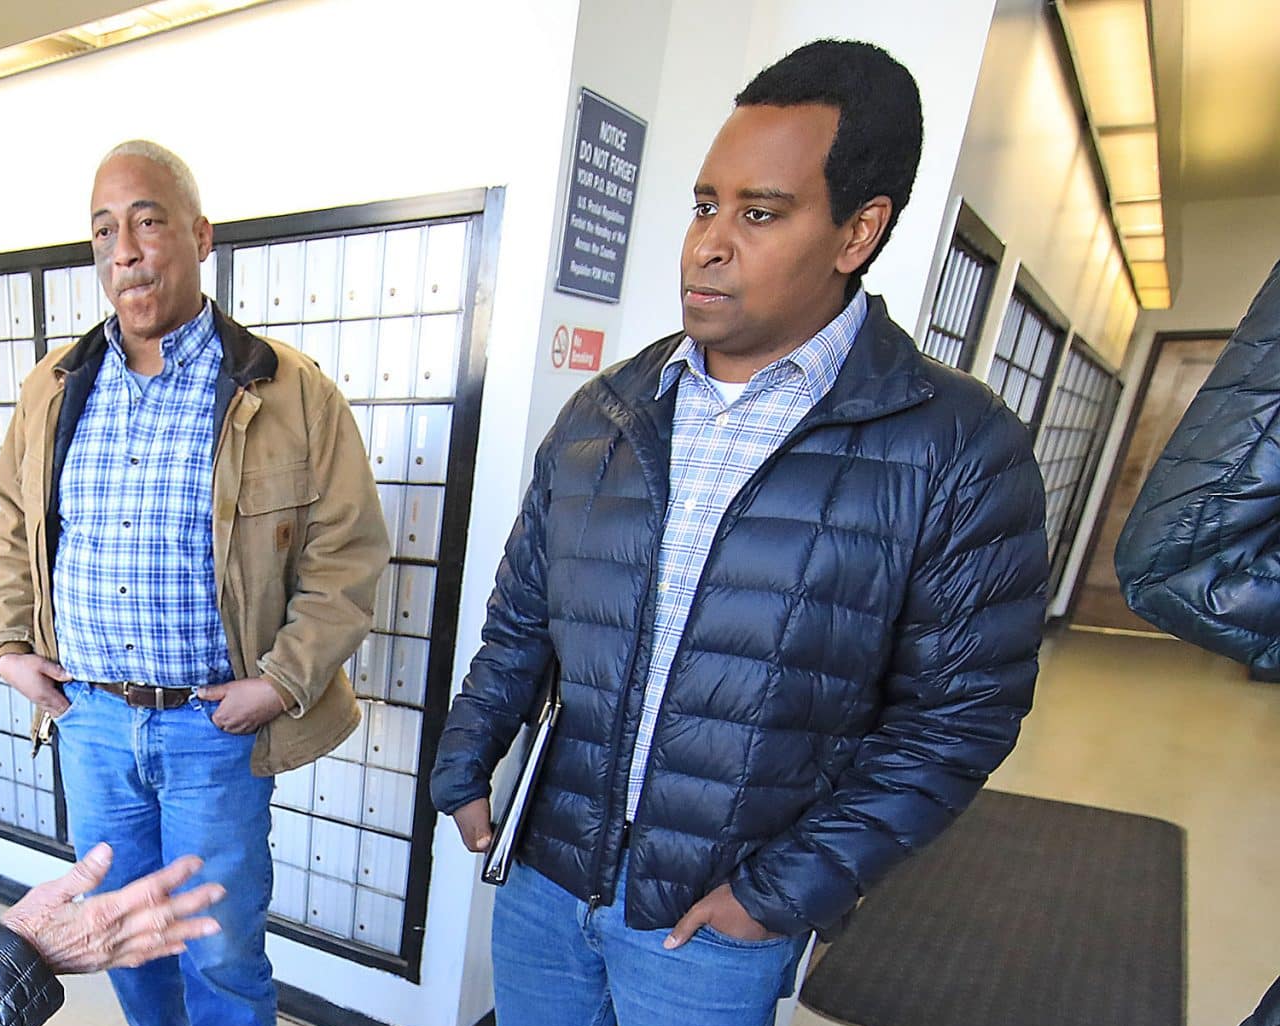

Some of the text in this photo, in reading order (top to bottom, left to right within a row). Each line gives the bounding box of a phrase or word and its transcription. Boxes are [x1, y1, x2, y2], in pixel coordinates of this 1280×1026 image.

[600, 120, 628, 152] NOTICE
[579, 140, 638, 184] DO NOT FORGET
